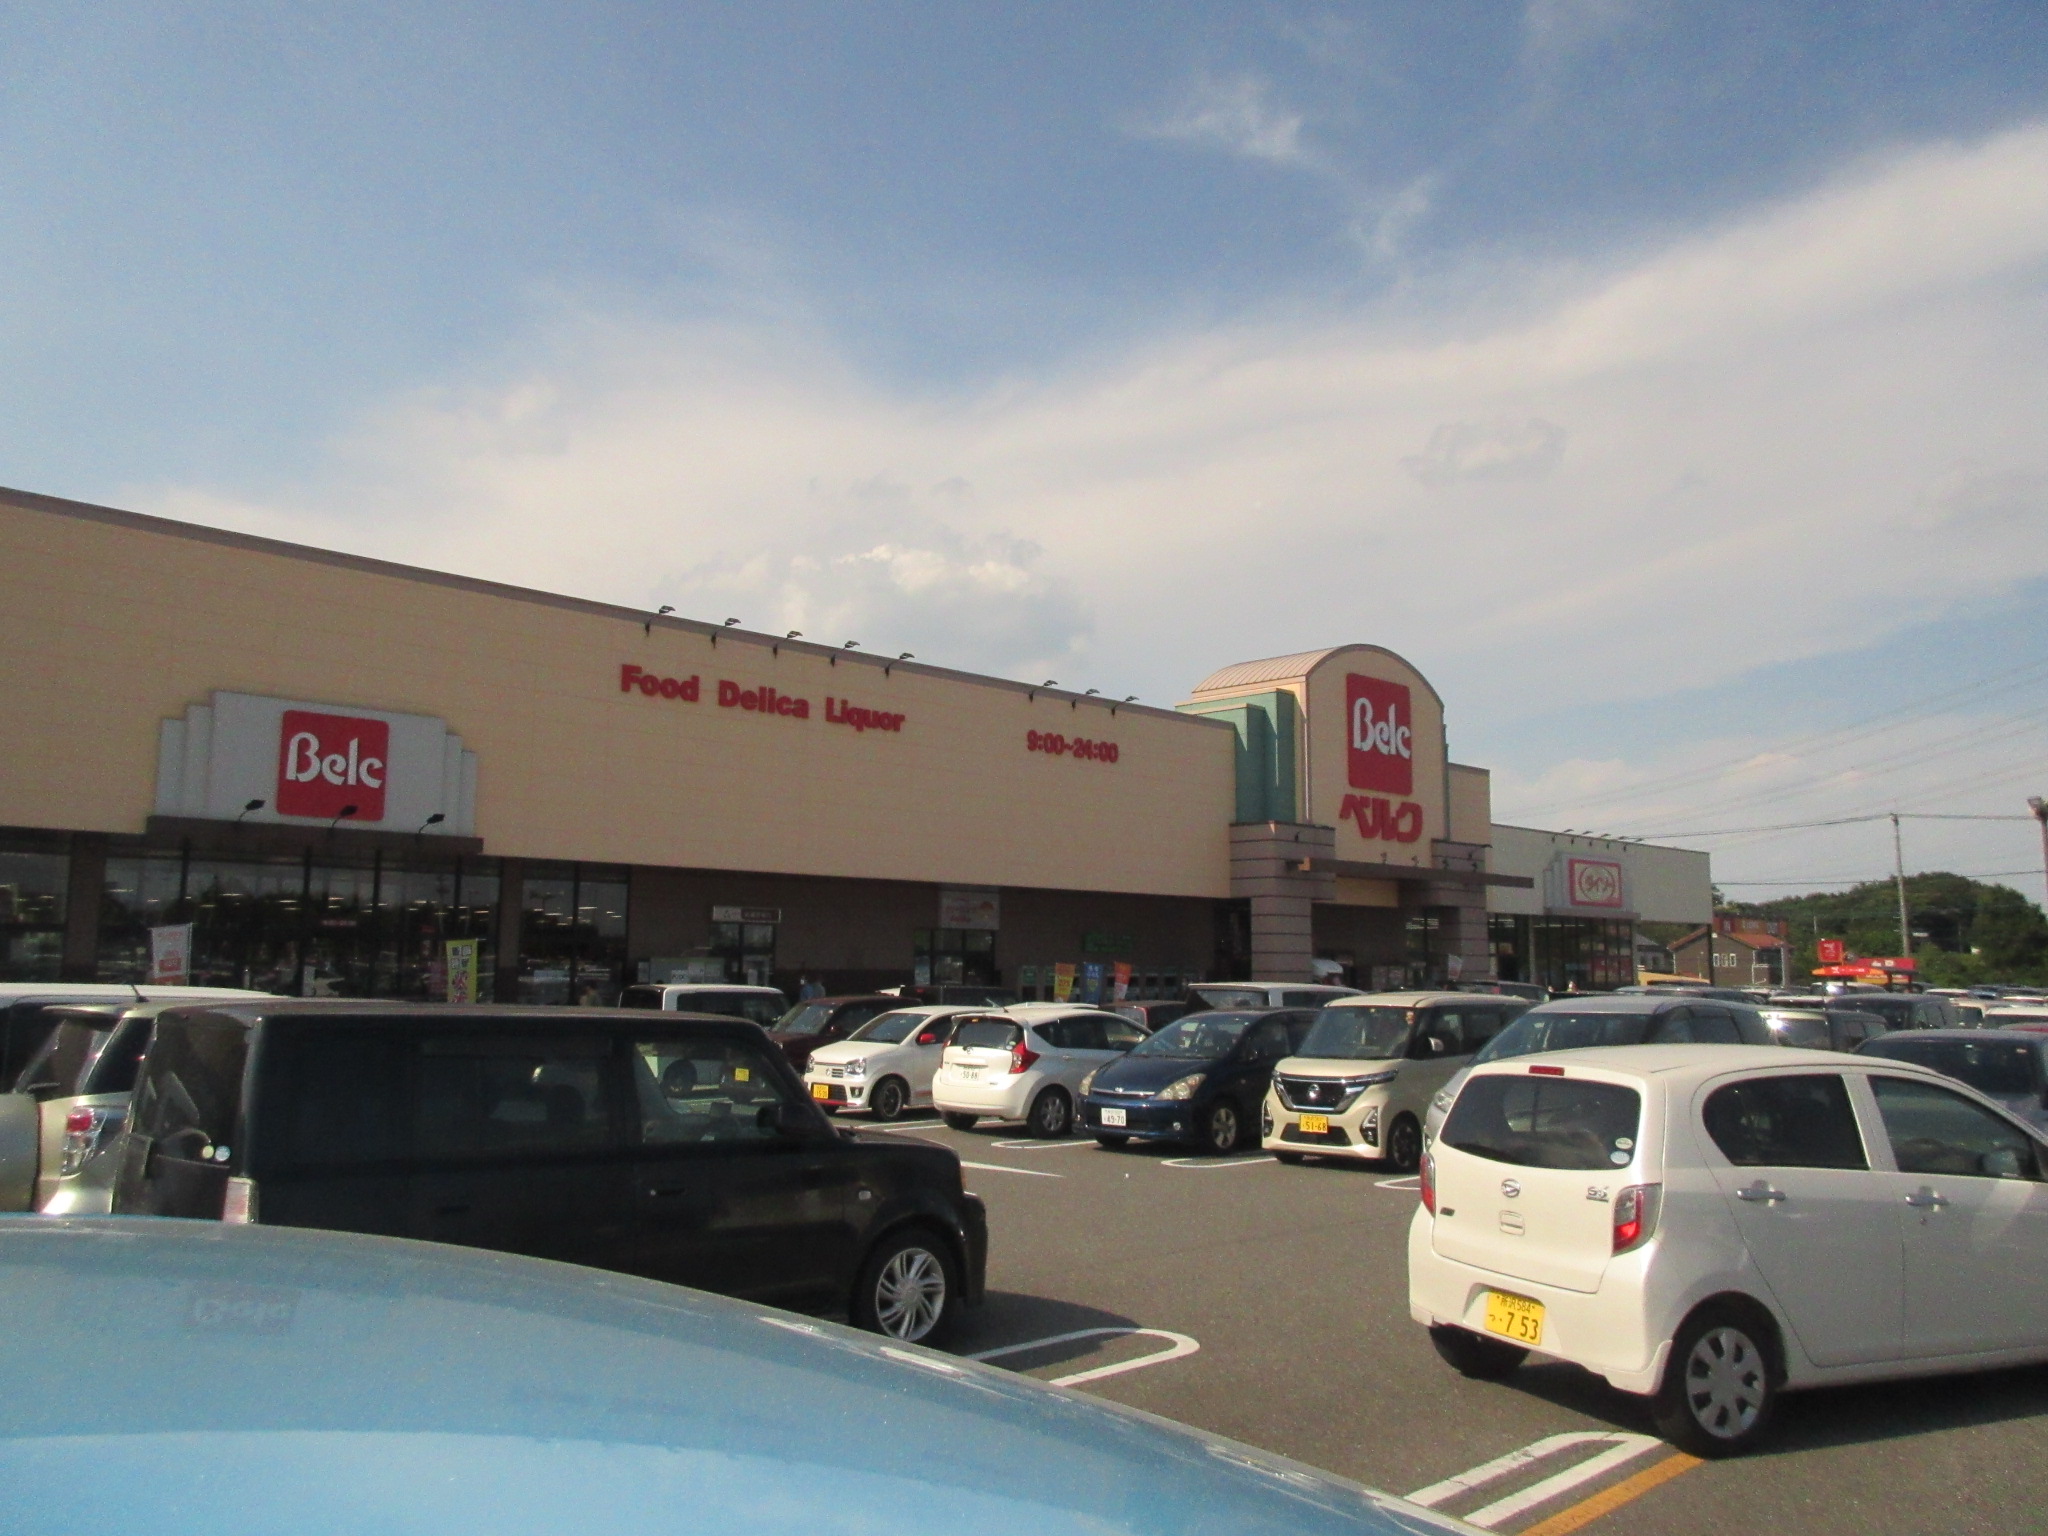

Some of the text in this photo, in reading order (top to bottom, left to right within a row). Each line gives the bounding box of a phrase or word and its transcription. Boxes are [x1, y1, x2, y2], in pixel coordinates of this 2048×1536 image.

[620, 664, 905, 732] Food Delica Liquor
[1352, 696, 1412, 760] Belc
[285, 731, 384, 789] Belc
[1338, 793, 1423, 843] ベルク
